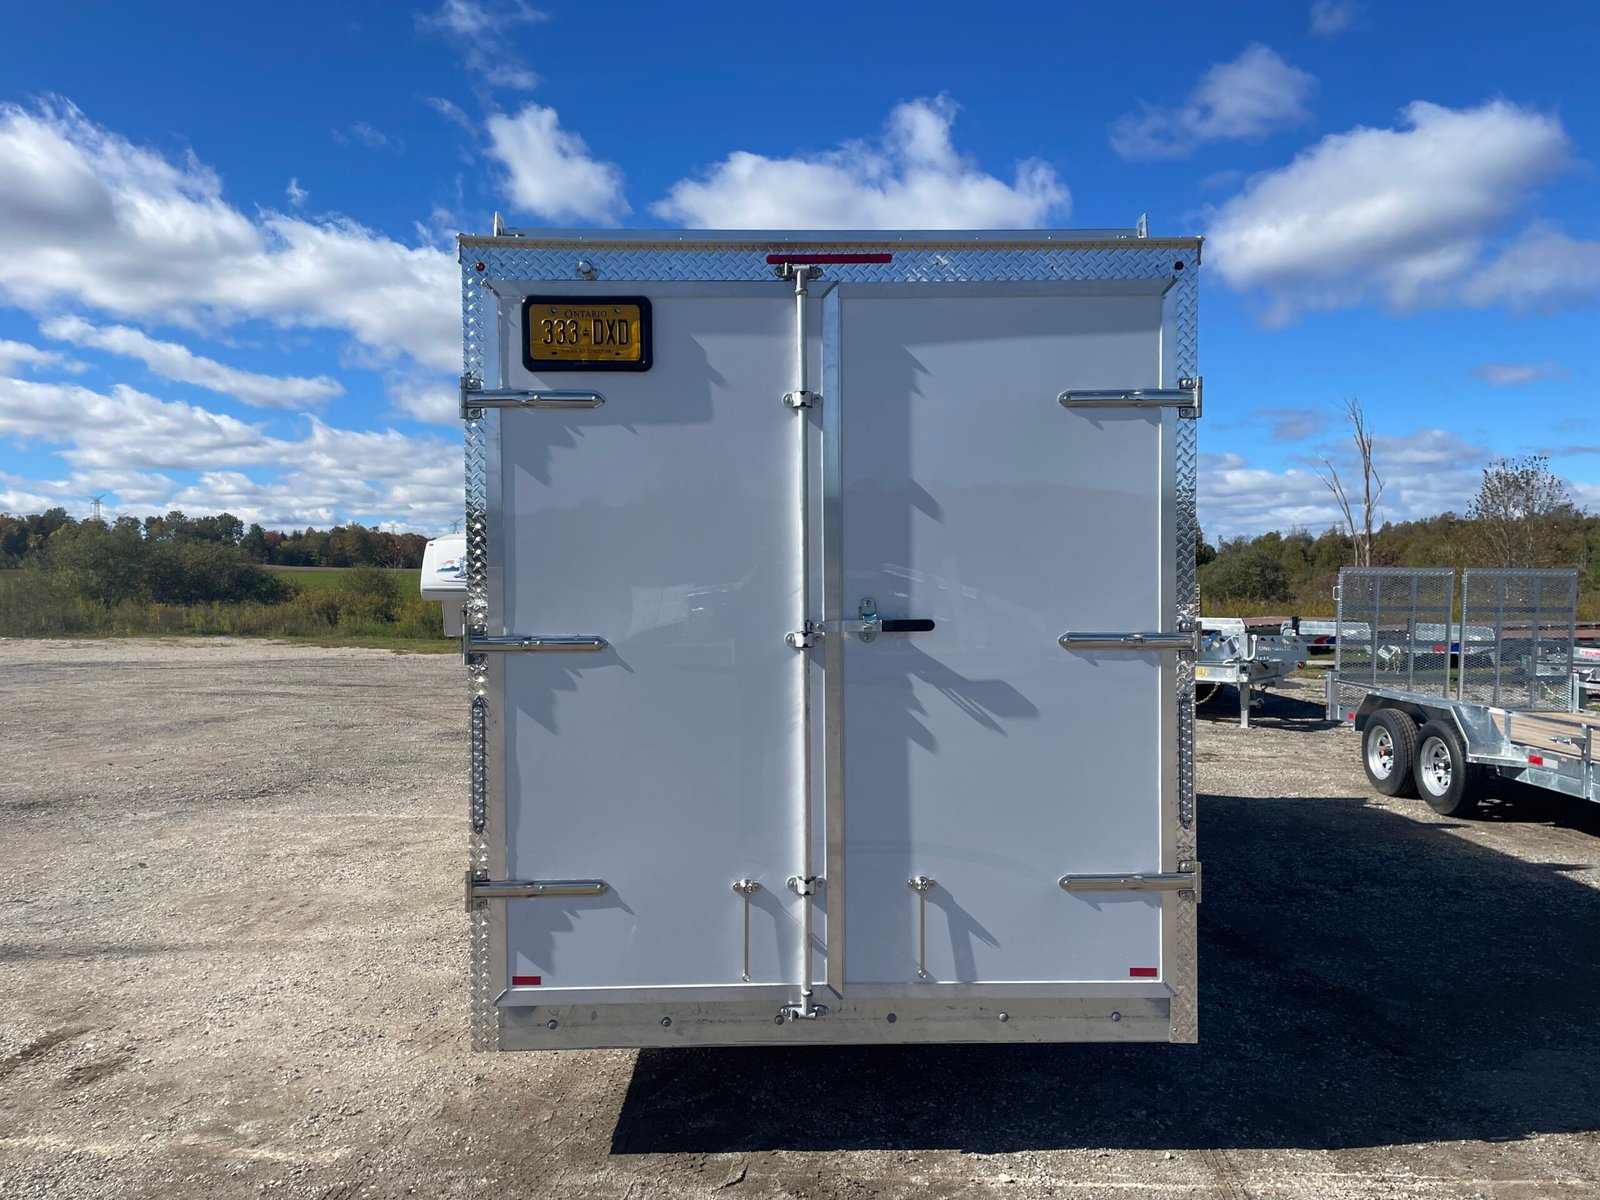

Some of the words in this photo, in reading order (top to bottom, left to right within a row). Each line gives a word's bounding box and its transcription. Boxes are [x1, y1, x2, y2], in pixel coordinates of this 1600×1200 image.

[564, 309, 607, 318] ONTARIO
[541, 319, 578, 345] 333
[592, 319, 629, 345] DXD
